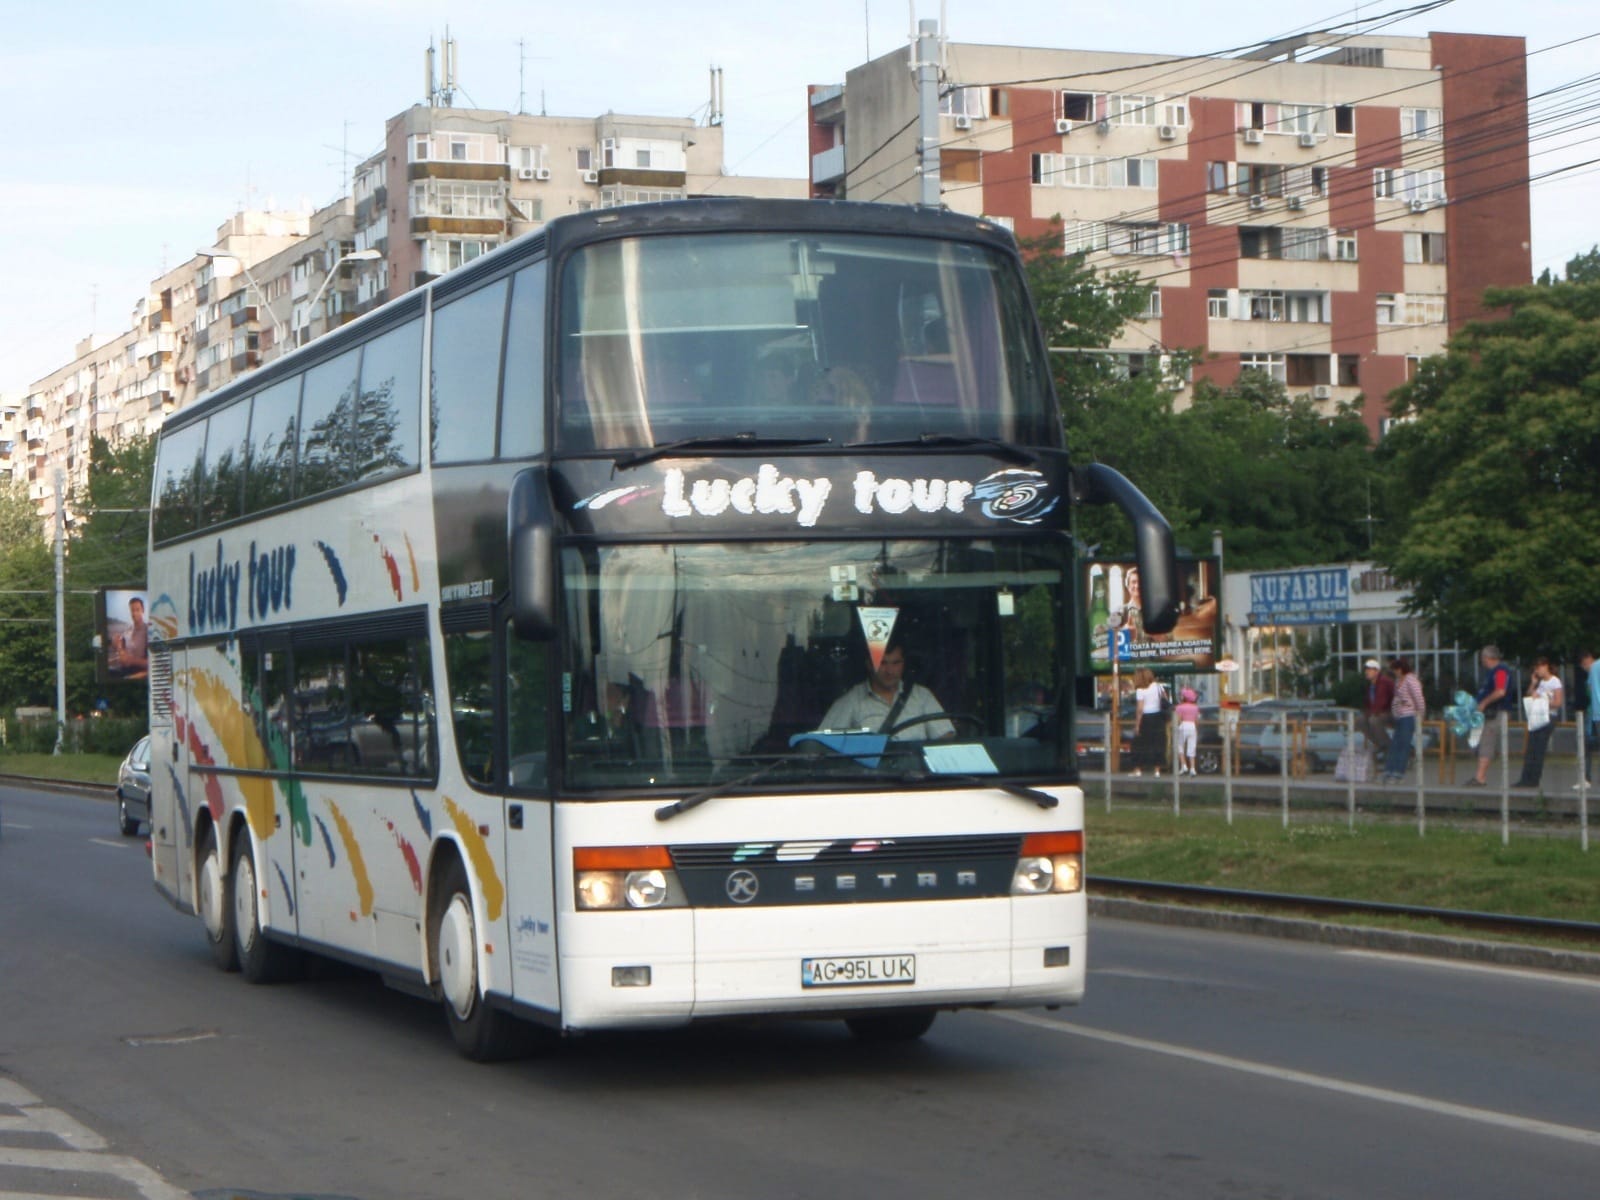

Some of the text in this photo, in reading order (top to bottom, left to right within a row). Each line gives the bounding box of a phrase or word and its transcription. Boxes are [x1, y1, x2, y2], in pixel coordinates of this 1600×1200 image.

[662, 463, 974, 527] Lucky tour
[248, 541, 296, 622] tour
[1252, 573, 1347, 601] NUFARUL
[794, 871, 977, 891] SETRA
